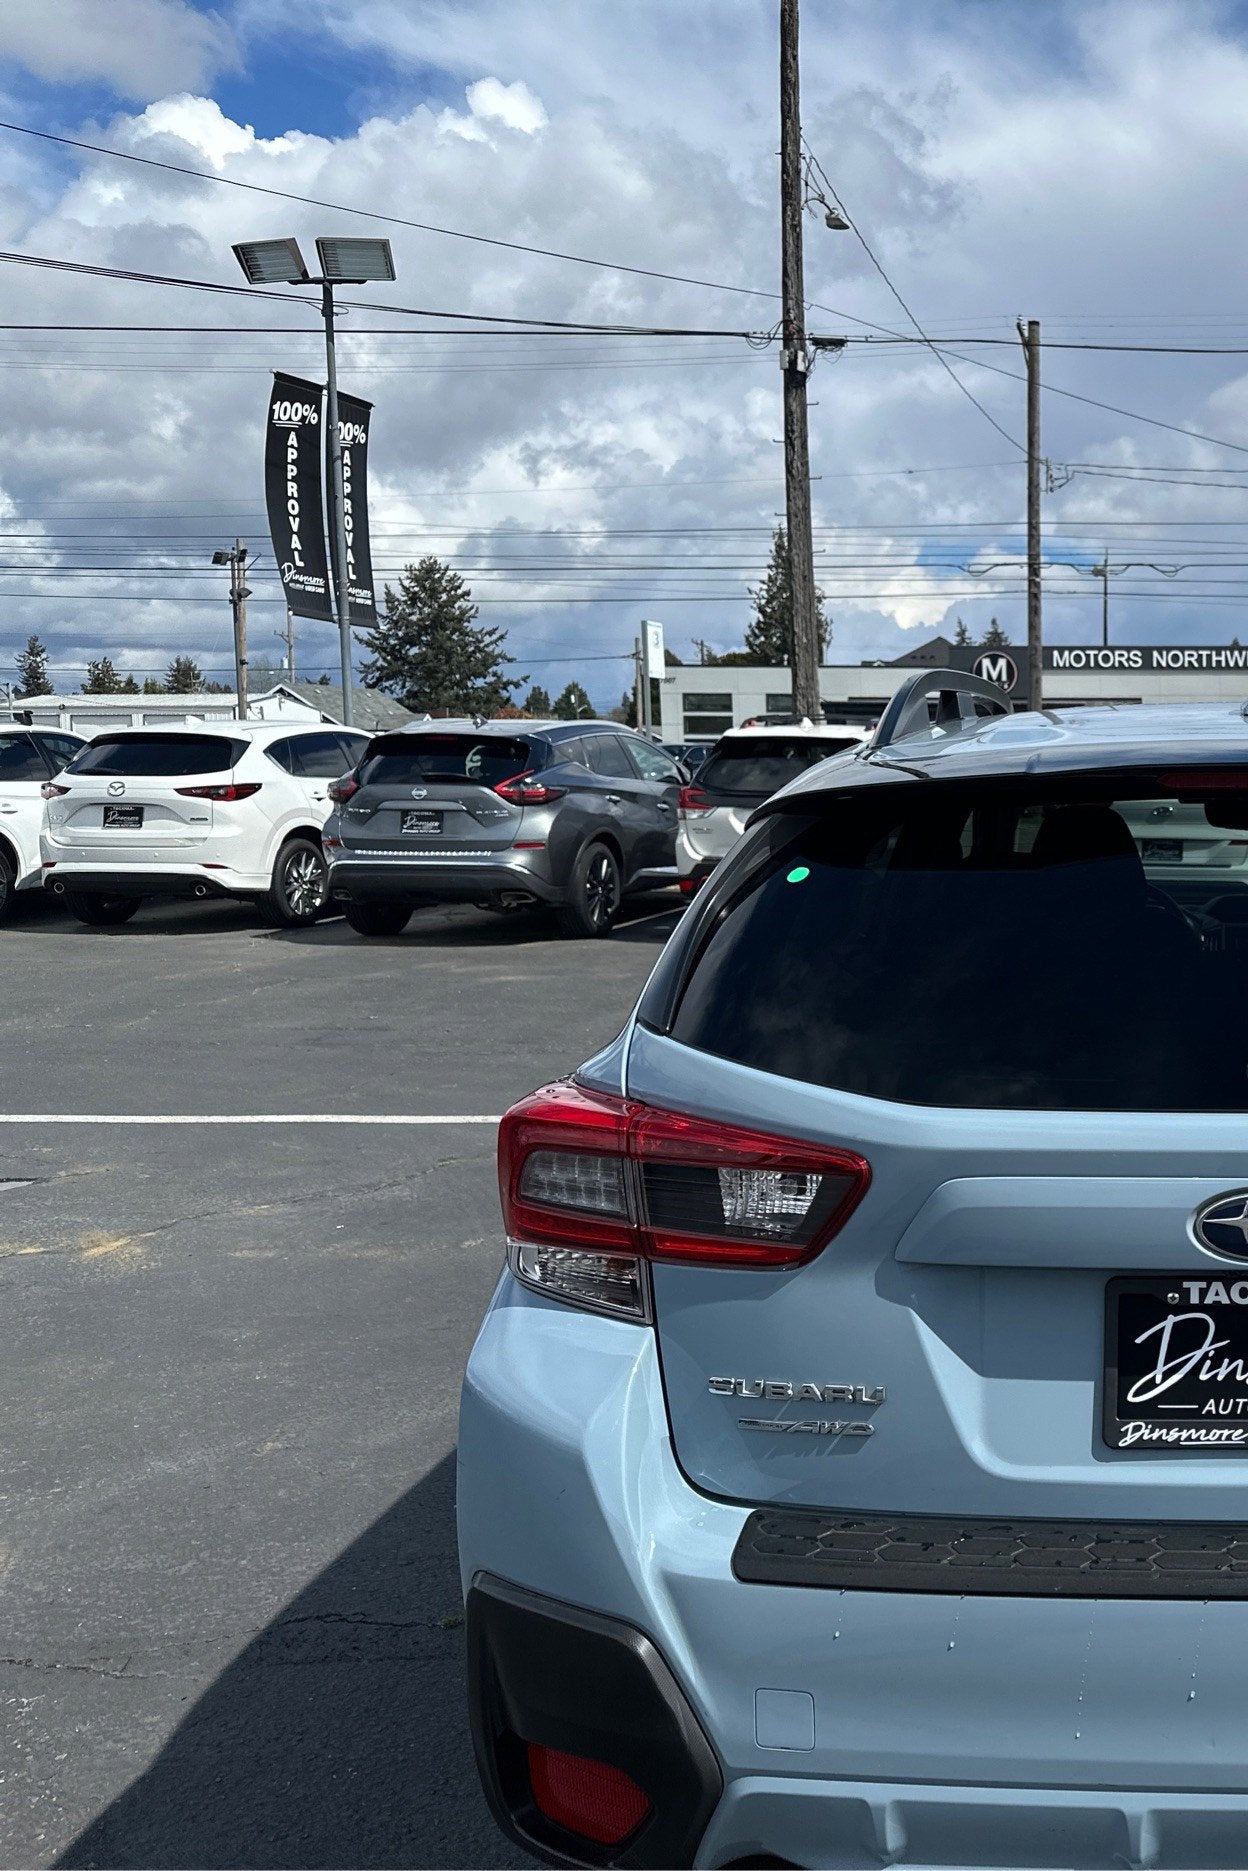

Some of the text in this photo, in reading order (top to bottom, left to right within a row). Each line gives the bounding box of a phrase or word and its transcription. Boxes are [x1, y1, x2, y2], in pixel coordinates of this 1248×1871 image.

[272, 401, 318, 425] 100%
[337, 421, 366, 444] 00%
[286, 431, 305, 567] APPROVAL
[342, 450, 357, 580] APPROVAL
[982, 657, 1007, 682] M
[1053, 650, 1143, 668] MOTORS
[708, 1376, 886, 1404] SUBARU
[787, 1419, 876, 1436] AWD
[1118, 1421, 1248, 1447] Dinsmore
